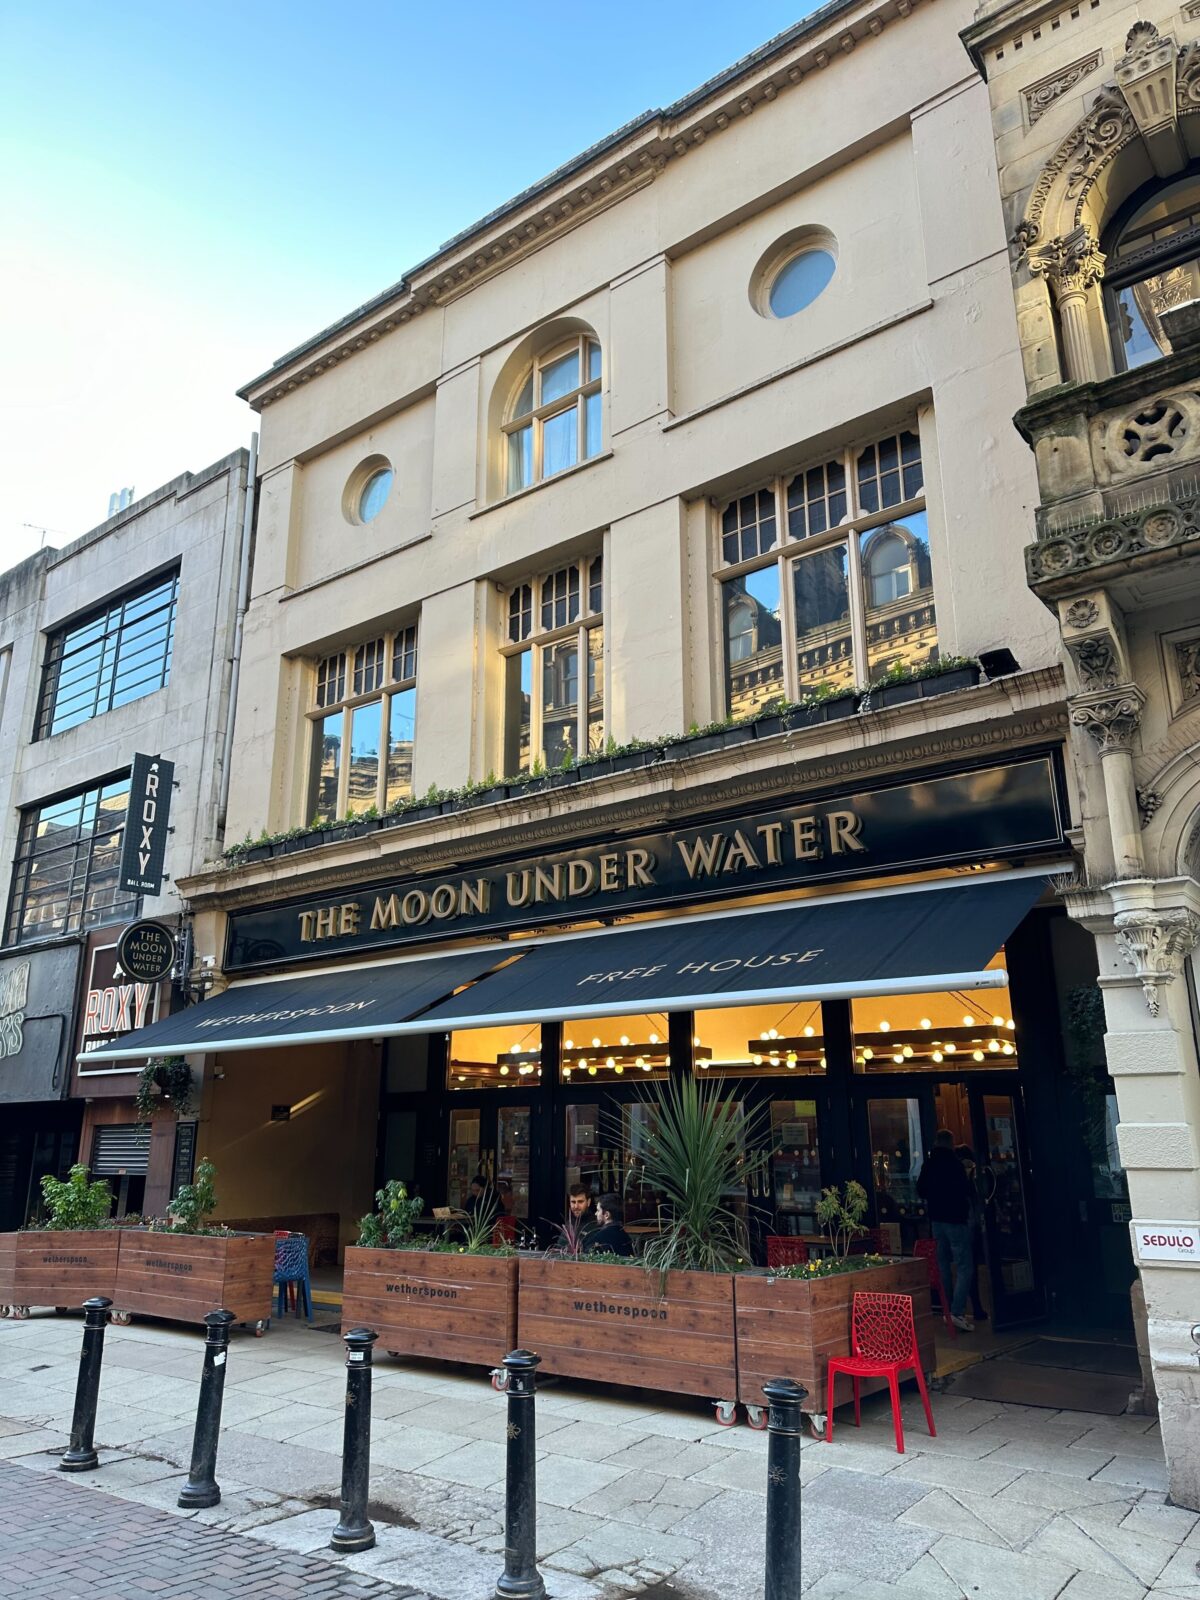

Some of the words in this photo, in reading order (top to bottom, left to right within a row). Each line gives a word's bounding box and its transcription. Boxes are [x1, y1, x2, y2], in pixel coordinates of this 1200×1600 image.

[139, 773, 160, 876] ROXY
[298, 902, 361, 943] THE
[370, 878, 491, 931] MOON
[505, 848, 658, 909] UNDER
[677, 810, 868, 880] WATER
[140, 931, 161, 942] THE
[130, 941, 167, 954] MOON
[132, 952, 162, 963] UNDER
[132, 962, 161, 972] WATER
[576, 964, 668, 986] FREE
[676, 948, 825, 974] HOUSE
[84, 983, 152, 1035] ROXY
[194, 999, 377, 1028] WETHERSPOON
[1142, 1234, 1194, 1247] SEDULO
[42, 1255, 88, 1265] wetherspoon
[144, 1259, 193, 1272] wetherspoon
[385, 1282, 458, 1299] wetherspoon
[573, 1300, 668, 1320] wetherspoon
